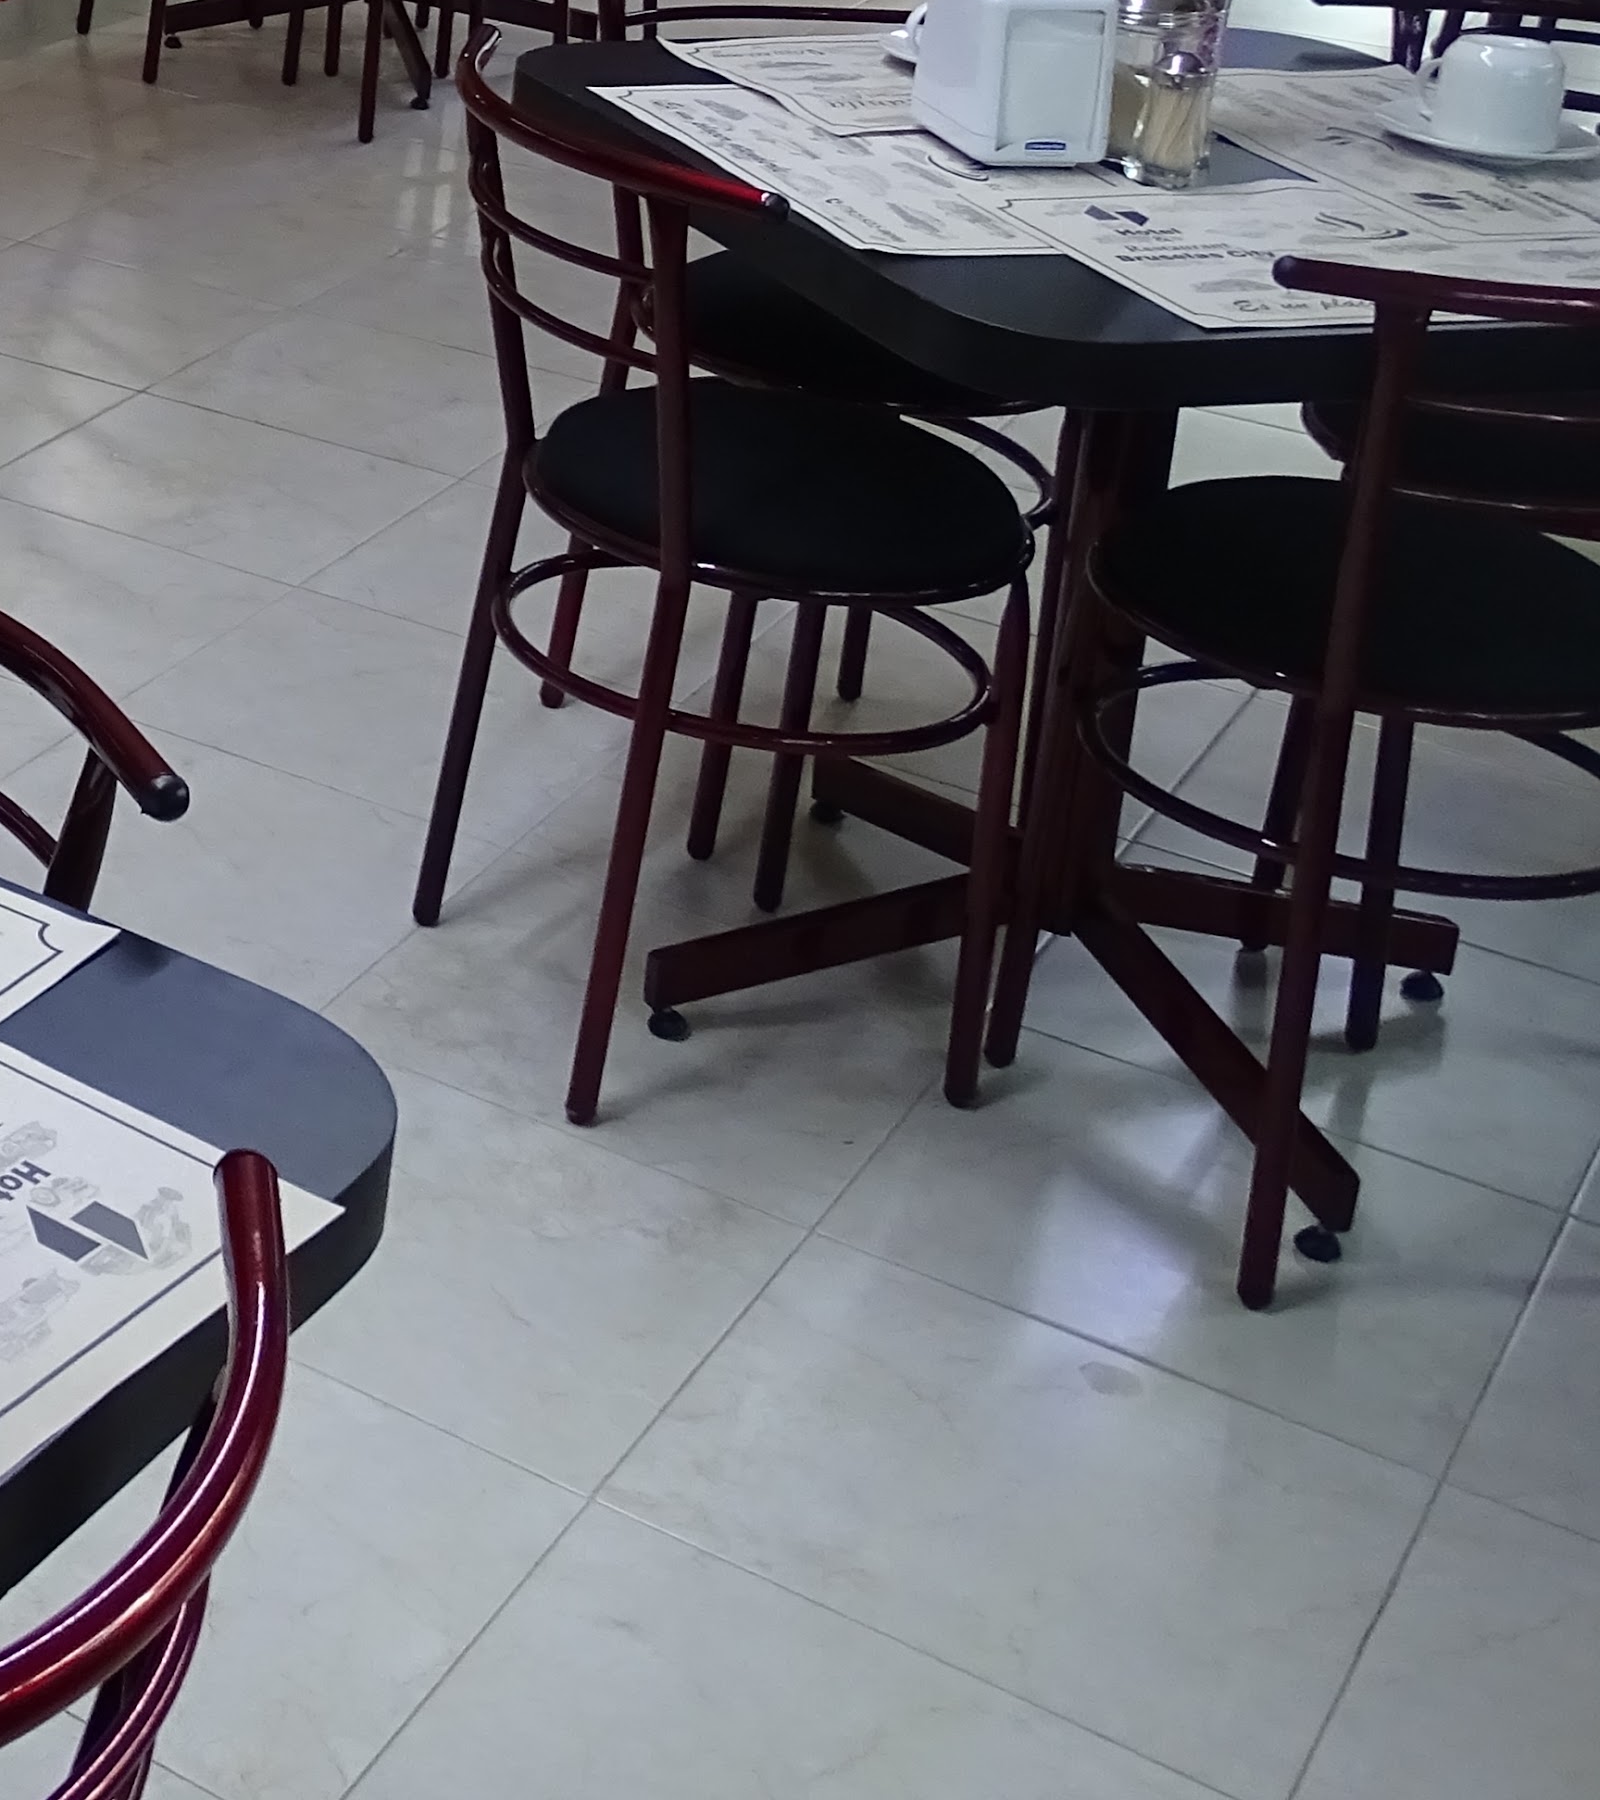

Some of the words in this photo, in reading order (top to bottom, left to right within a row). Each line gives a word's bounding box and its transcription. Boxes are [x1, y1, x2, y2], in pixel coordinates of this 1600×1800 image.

[1114, 227, 1183, 238] Hotel
[1115, 251, 1224, 263] Bruselas
[1233, 300, 1270, 312] Es
